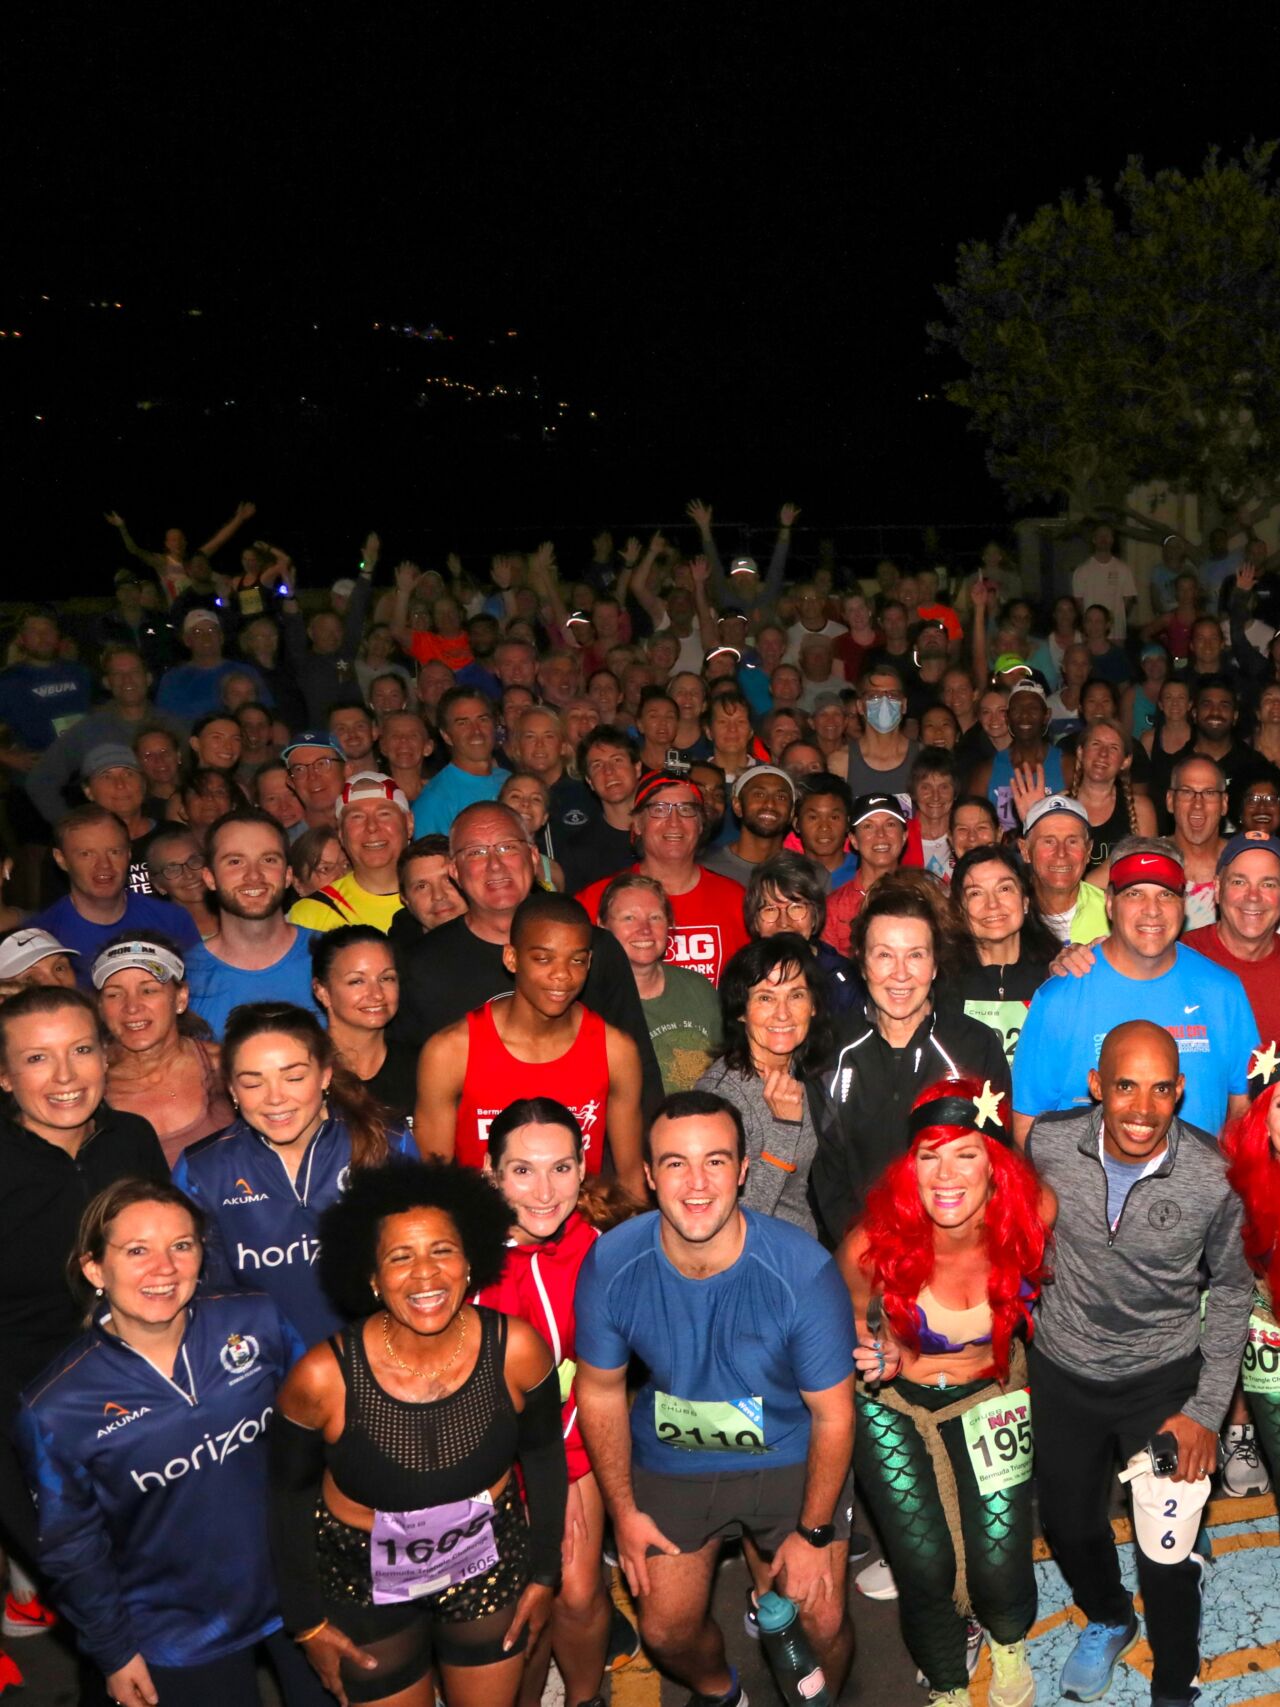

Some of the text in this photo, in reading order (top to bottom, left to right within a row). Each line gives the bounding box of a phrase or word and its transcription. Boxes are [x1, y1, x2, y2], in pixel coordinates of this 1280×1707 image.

[222, 1193, 270, 1206] AKUMA
[660, 1404, 698, 1418] CHUBB
[737, 1401, 754, 1418] Wave
[97, 1406, 152, 1439] AKUMA
[979, 1467, 1010, 1483] Bermuda
[1163, 1499, 1177, 1518] 2
[1160, 1530, 1176, 1550] 6
[458, 1554, 498, 1578] 1605
